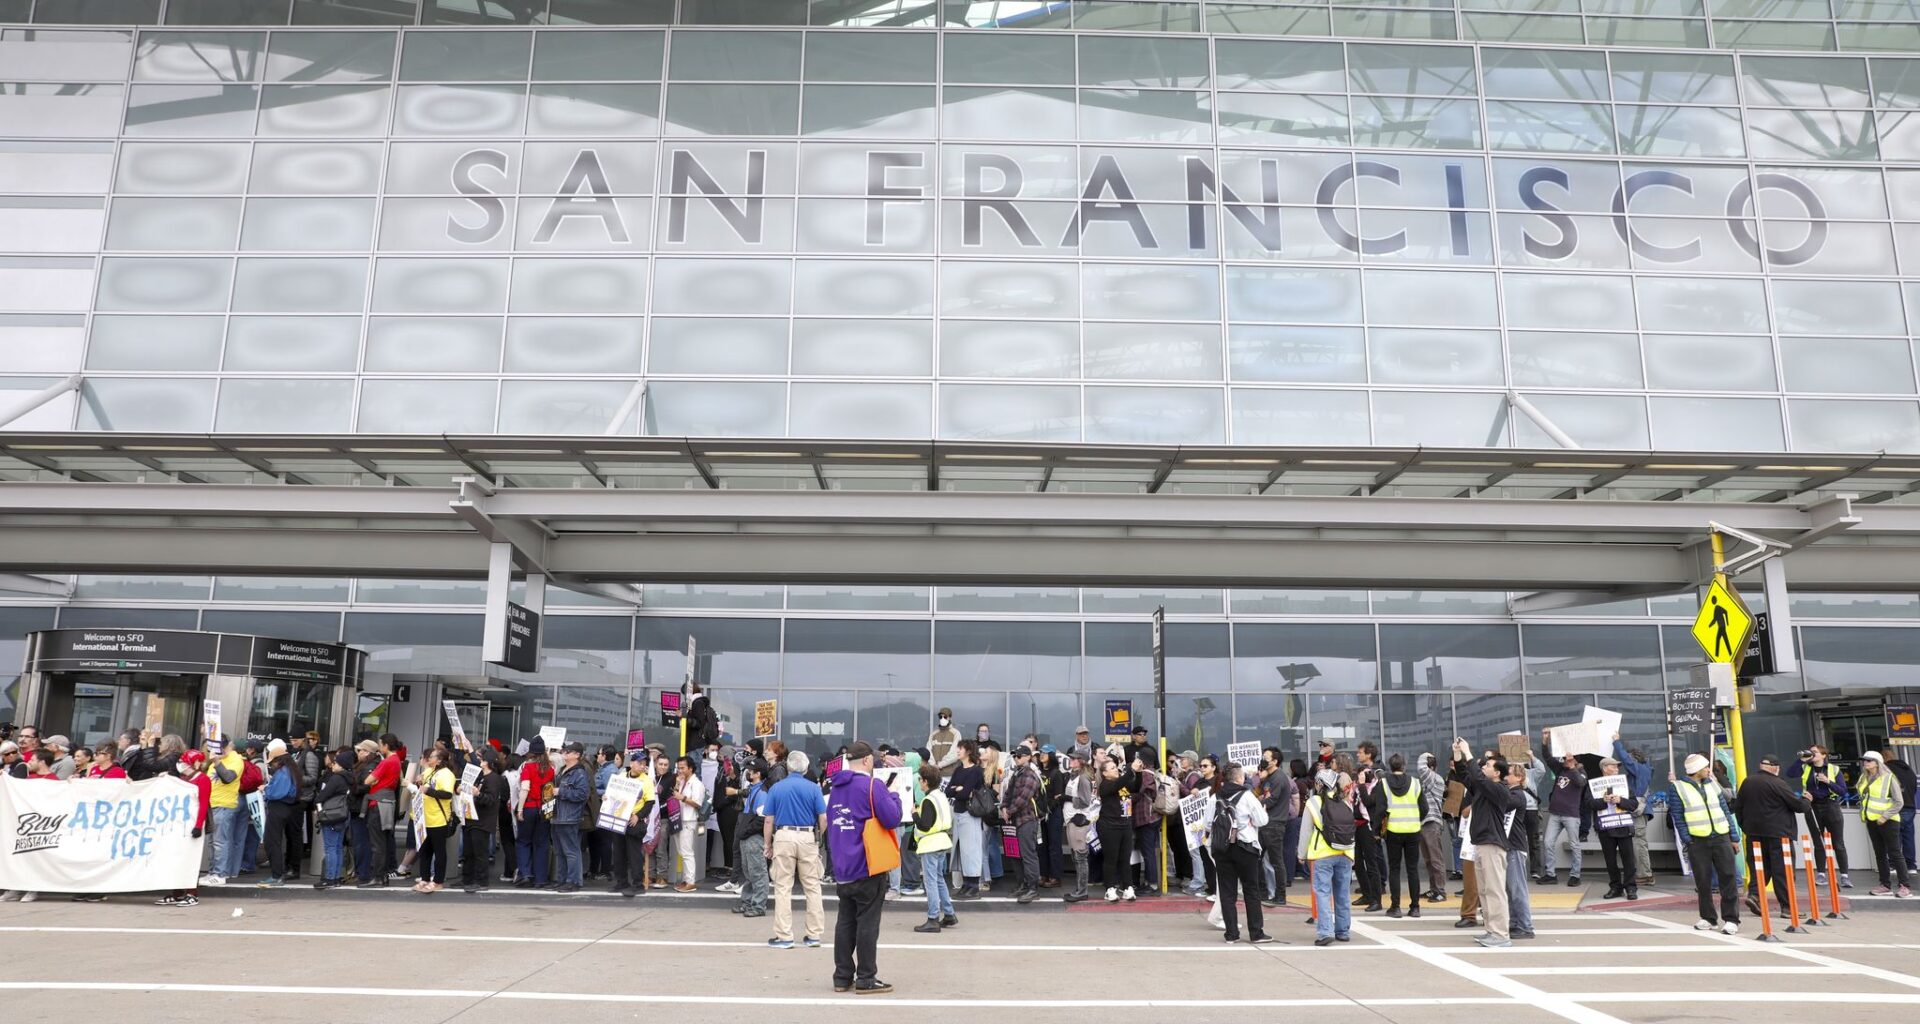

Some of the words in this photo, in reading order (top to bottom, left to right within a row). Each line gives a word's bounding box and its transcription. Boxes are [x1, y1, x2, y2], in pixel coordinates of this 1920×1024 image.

[446, 148, 767, 244] SAN
[864, 150, 1829, 267] FRANCISCO
[1758, 616, 1766, 630] 3
[84, 633, 116, 641] Welcome
[126, 633, 144, 642] SFO
[72, 643, 119, 651] International
[120, 643, 157, 652] Terminal
[280, 643, 310, 654] Welcome
[317, 647, 329, 656] SFO
[267, 651, 312, 663] International
[313, 656, 336, 666] Terminal
[247, 732, 265, 740] Door
[265, 732, 272, 740] 4
[1231, 748, 1260, 759] DESERVE
[68, 794, 192, 829] ABOLISH
[1183, 796, 1208, 815] DESERVE
[16, 812, 68, 836] Bay
[15, 834, 62, 850] RESISTANCE
[111, 827, 156, 860] ICE
